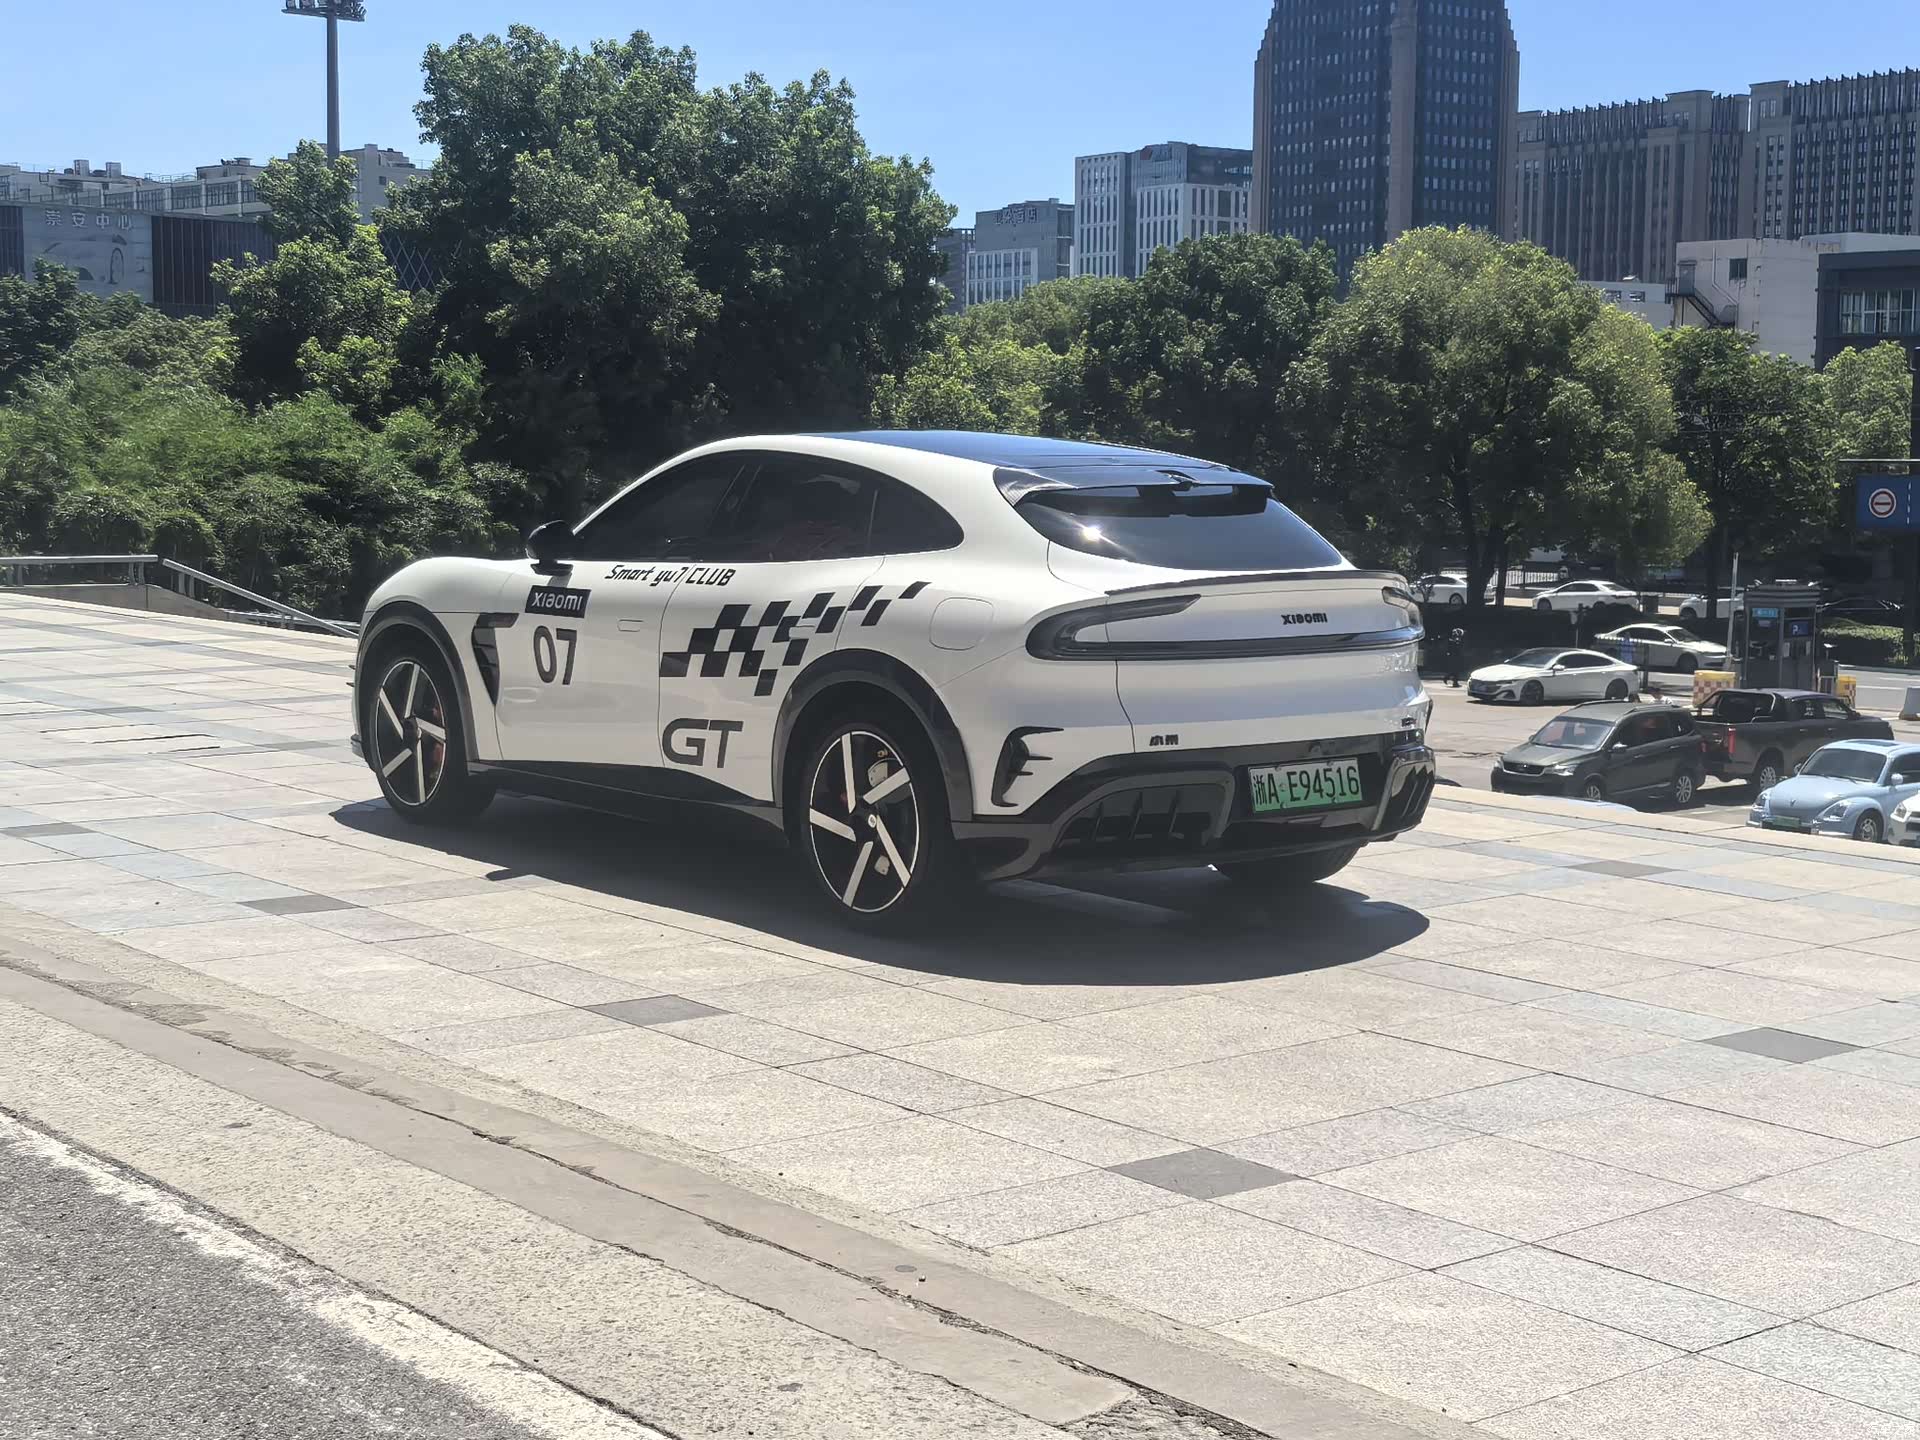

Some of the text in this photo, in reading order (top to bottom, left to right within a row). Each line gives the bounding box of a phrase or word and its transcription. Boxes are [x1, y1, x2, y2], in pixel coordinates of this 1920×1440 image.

[604, 564, 657, 581] Smart
[685, 567, 737, 587] CLUB
[533, 625, 578, 685] 07
[662, 718, 744, 768] GT
